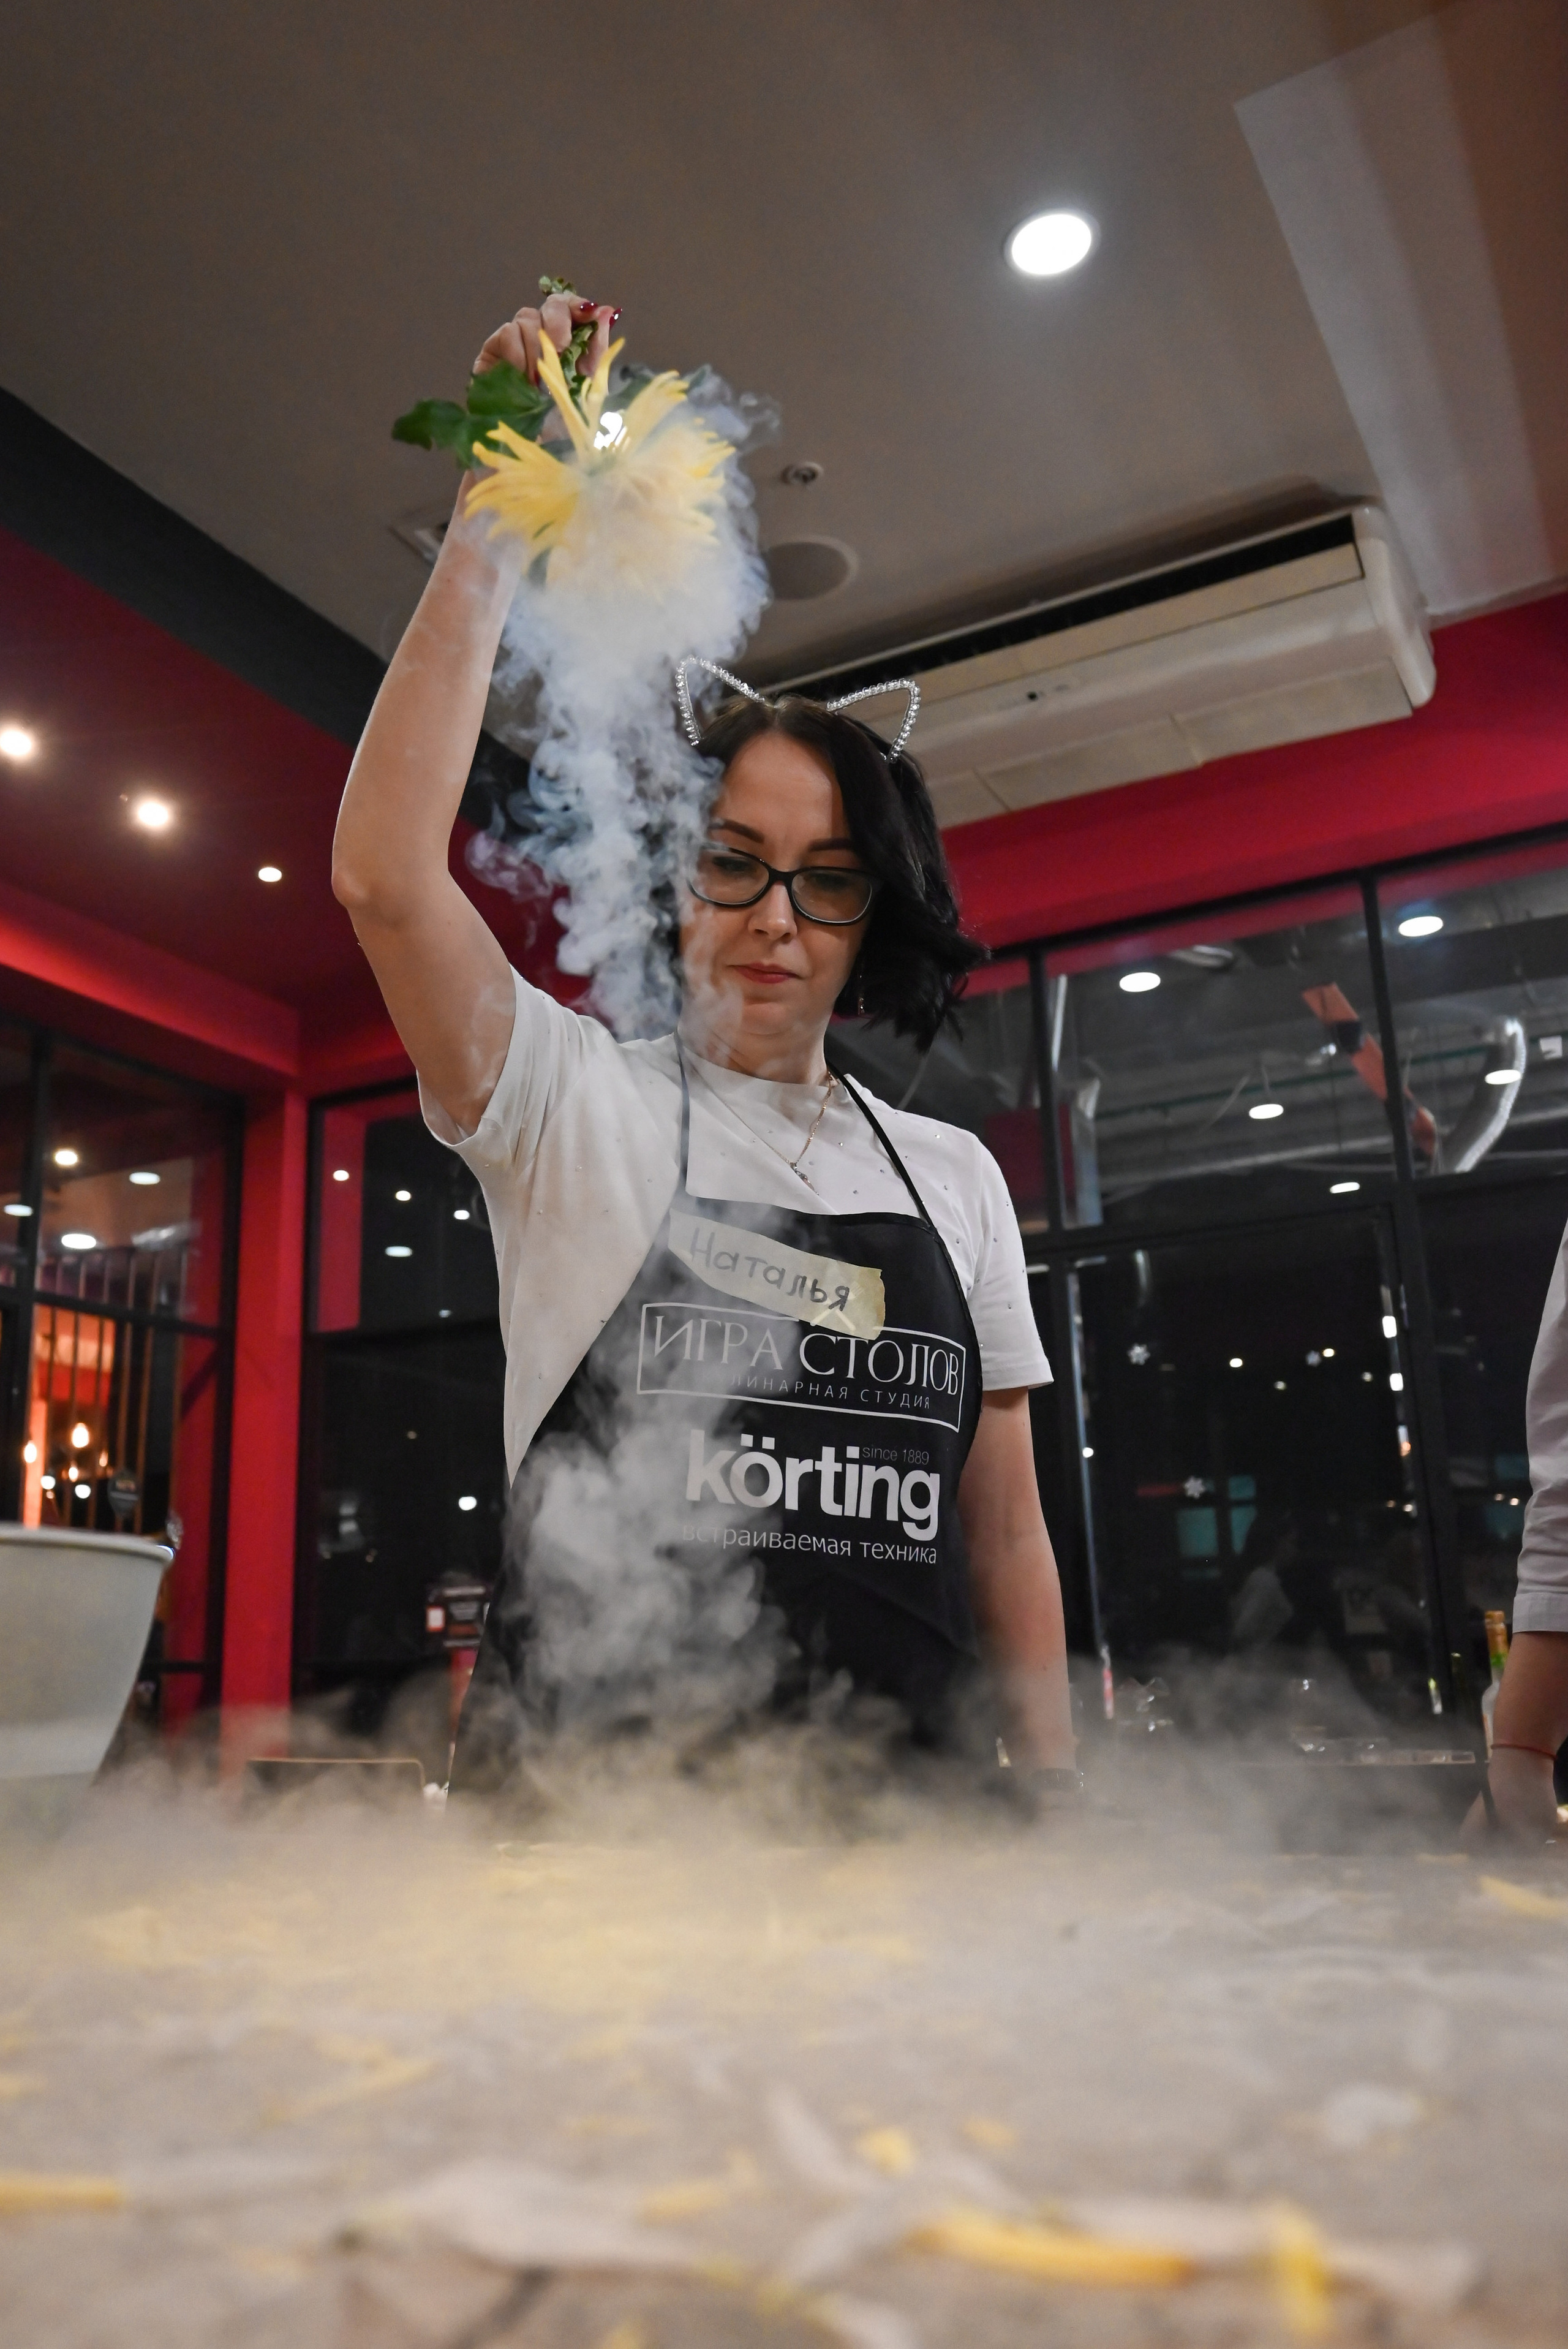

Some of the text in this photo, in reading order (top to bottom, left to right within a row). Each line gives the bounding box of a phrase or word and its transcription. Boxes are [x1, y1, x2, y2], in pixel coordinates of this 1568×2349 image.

[690, 1227, 850, 1311] Наталья
[654, 1315, 960, 1396] ИГРА СТОЛОВ
[729, 1374, 930, 1409] ЛИНАРНАЯ СТУДИЯ
[685, 1429, 941, 1541] körting
[862, 1445, 930, 1466] since 1889
[682, 1524, 937, 1564] встраиваемая техника
